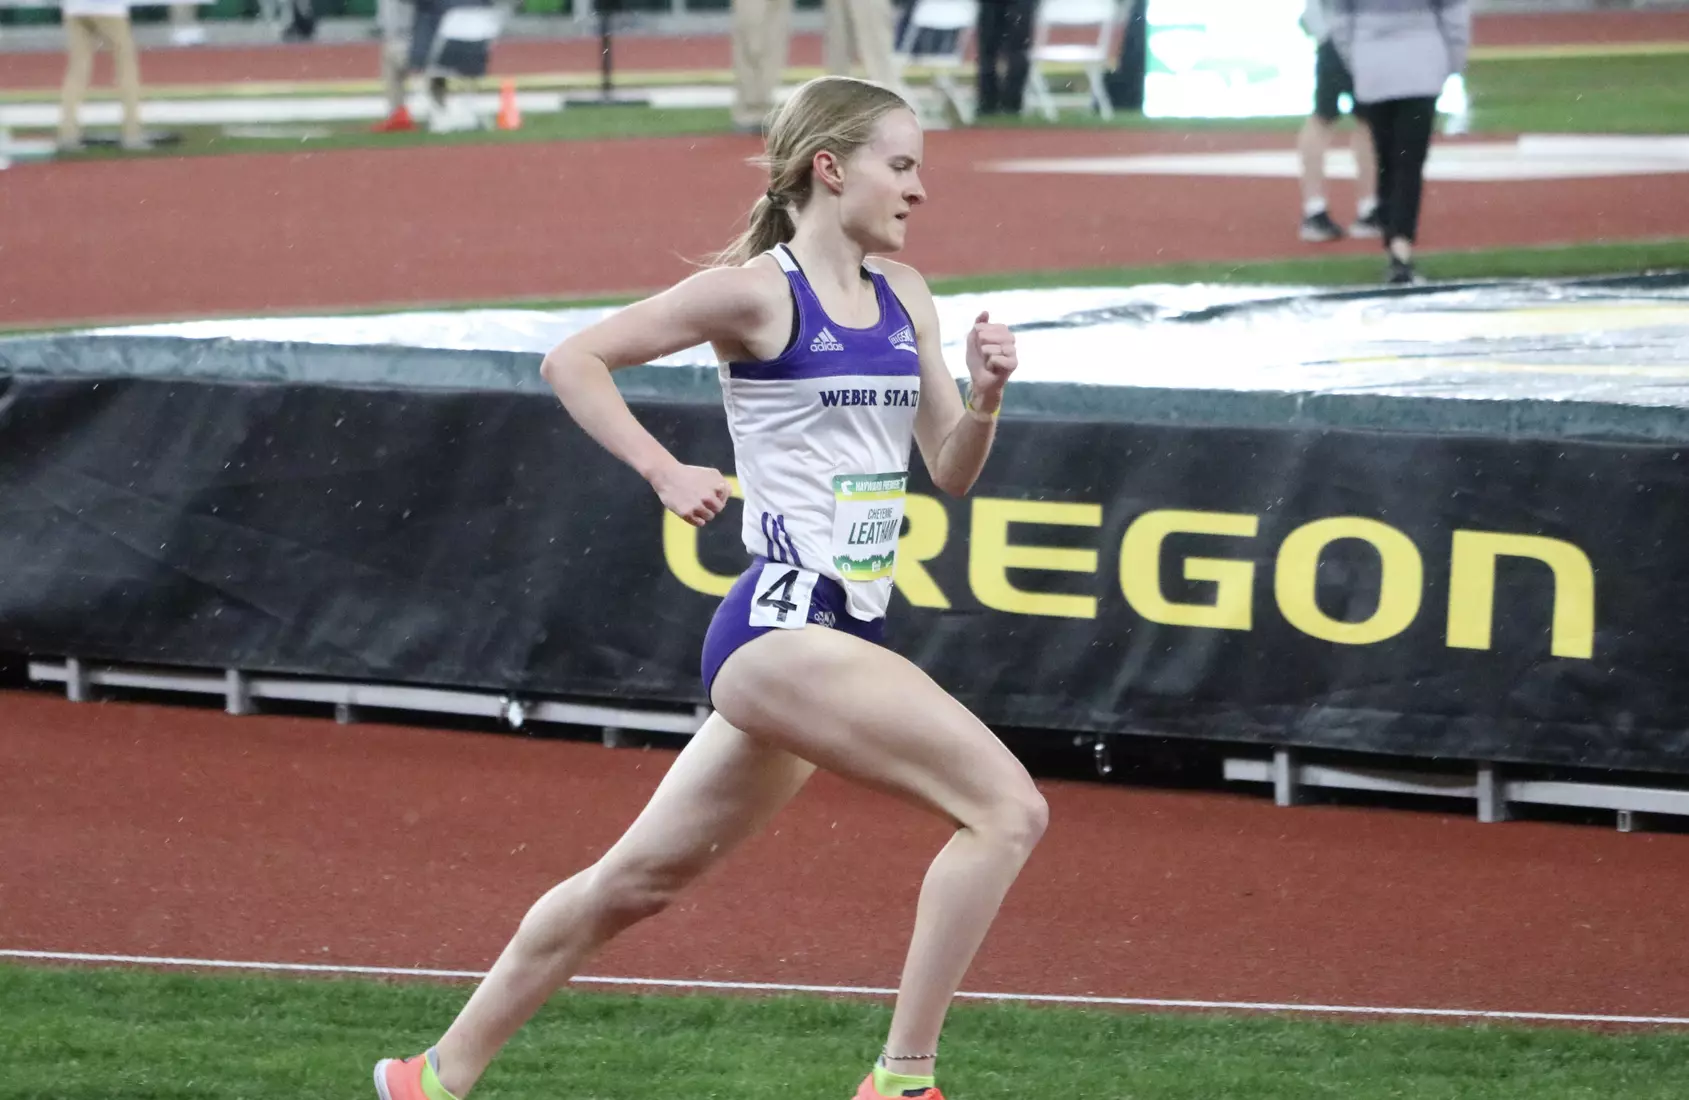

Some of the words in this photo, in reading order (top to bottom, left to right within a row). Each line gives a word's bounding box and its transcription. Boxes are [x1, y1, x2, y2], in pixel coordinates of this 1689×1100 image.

[810, 341, 844, 352] adidas
[819, 389, 877, 407] WEBER
[848, 520, 898, 545] LEATHAM
[757, 569, 799, 622] 4
